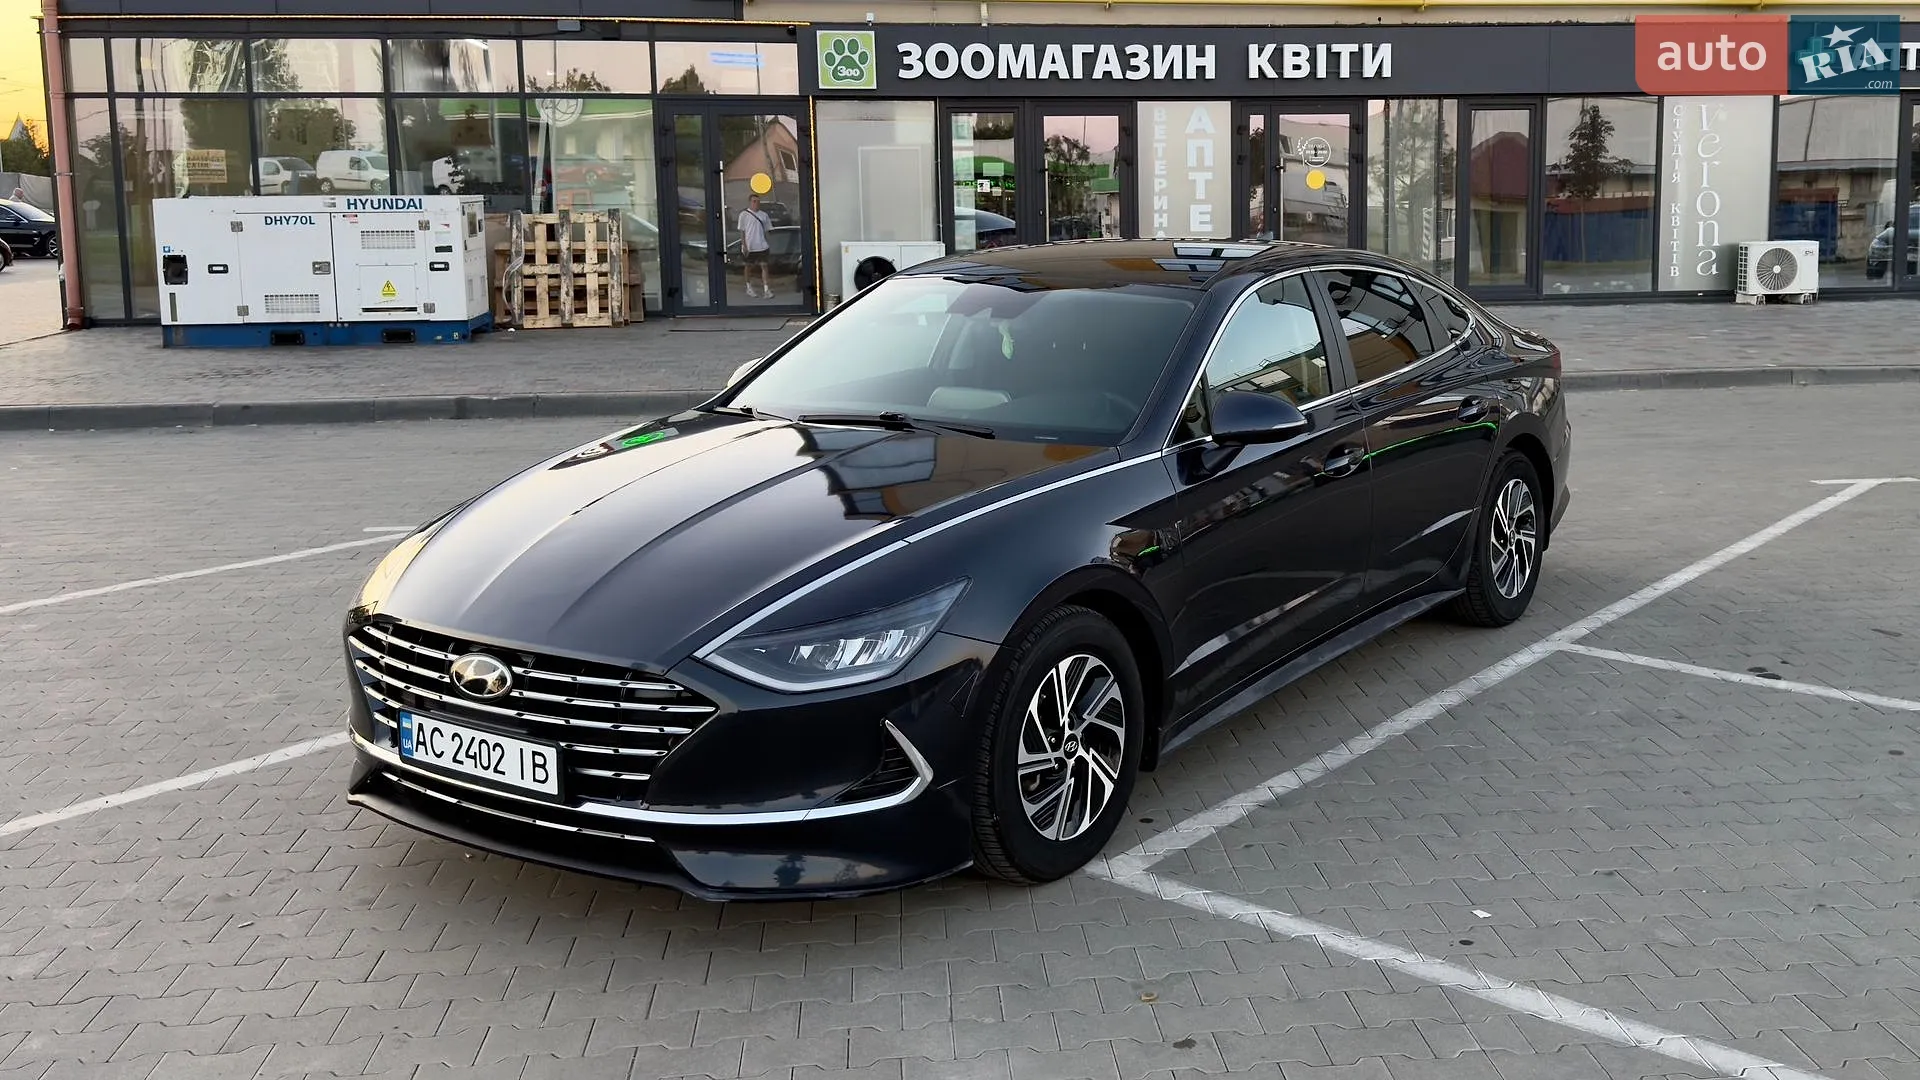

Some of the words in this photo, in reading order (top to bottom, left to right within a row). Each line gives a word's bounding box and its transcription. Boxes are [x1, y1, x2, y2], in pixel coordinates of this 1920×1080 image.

[897, 42, 1217, 80] ЗООМАГАЗИН
[1247, 42, 1393, 80] КВІТИ
[1671, 104, 1684, 184] СТУДІЯ
[264, 215, 316, 226] DHY70L
[346, 198, 423, 210] HYUNDAI
[1670, 202, 1681, 277] КВІТІВ
[403, 738, 413, 749] UA
[415, 722, 445, 759] AC
[451, 732, 506, 776] 2402
[519, 747, 550, 785] IB
